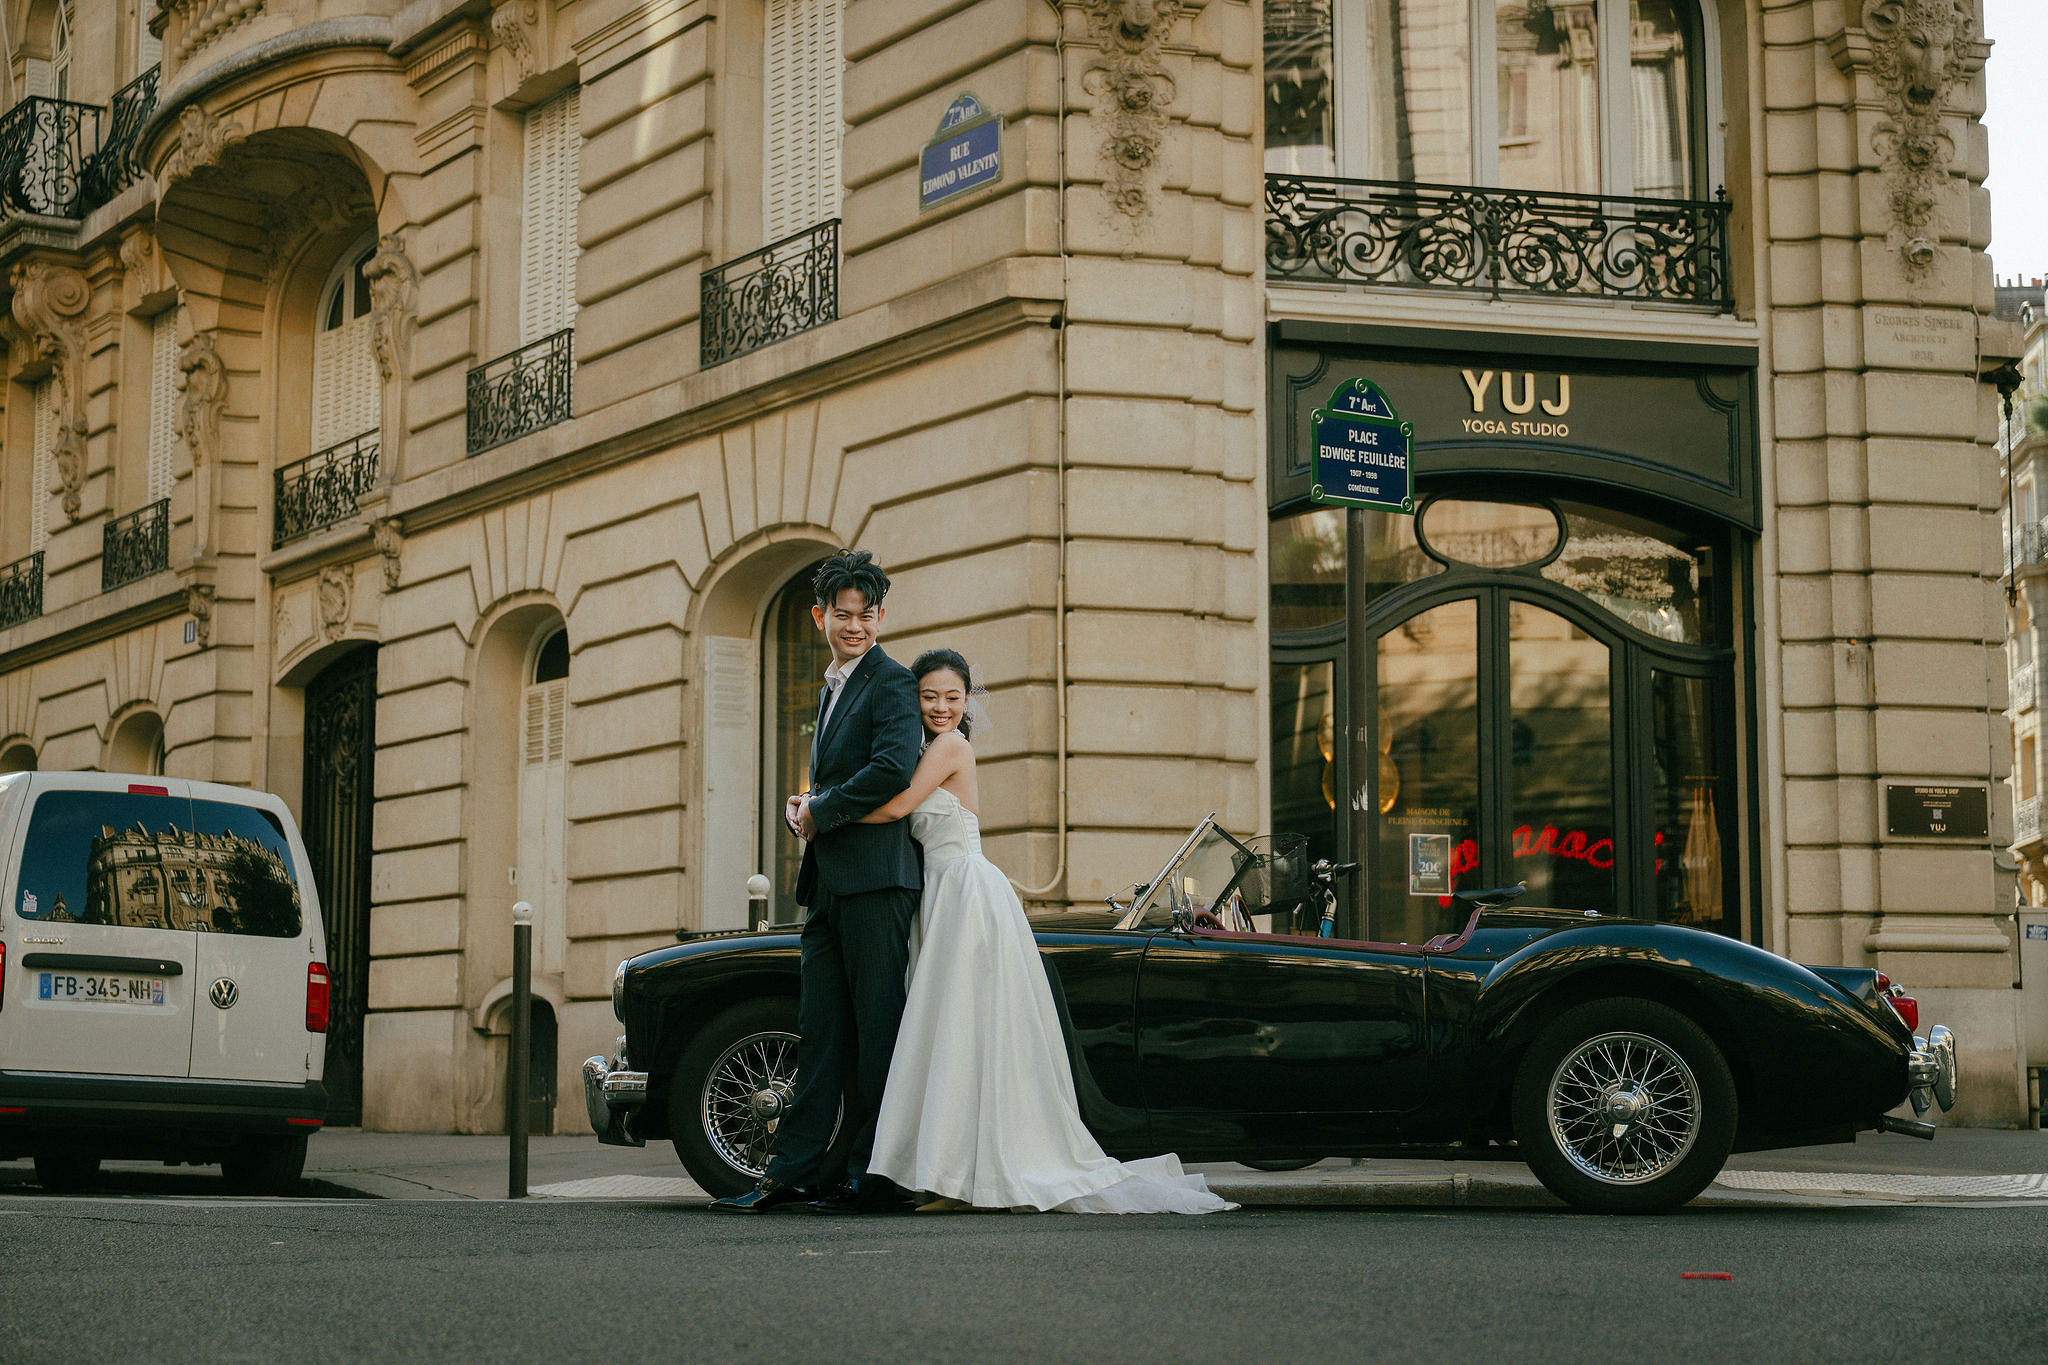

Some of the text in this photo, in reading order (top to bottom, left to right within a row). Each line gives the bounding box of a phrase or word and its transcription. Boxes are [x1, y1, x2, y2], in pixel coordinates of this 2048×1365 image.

[950, 141, 970, 162] RUE
[923, 152, 999, 195] EDMOND VALENTIN
[1462, 369, 1570, 416] YUJ
[1348, 429, 1378, 446] PLACE
[1462, 419, 1569, 437] YOGA STUDIO
[1320, 444, 1406, 470] EDWIGE FEUILLÈRE
[1347, 483, 1379, 495] COMÉDIENNE
[1929, 823, 1947, 833] YUJ
[54, 975, 151, 1000] FB-345-NH
